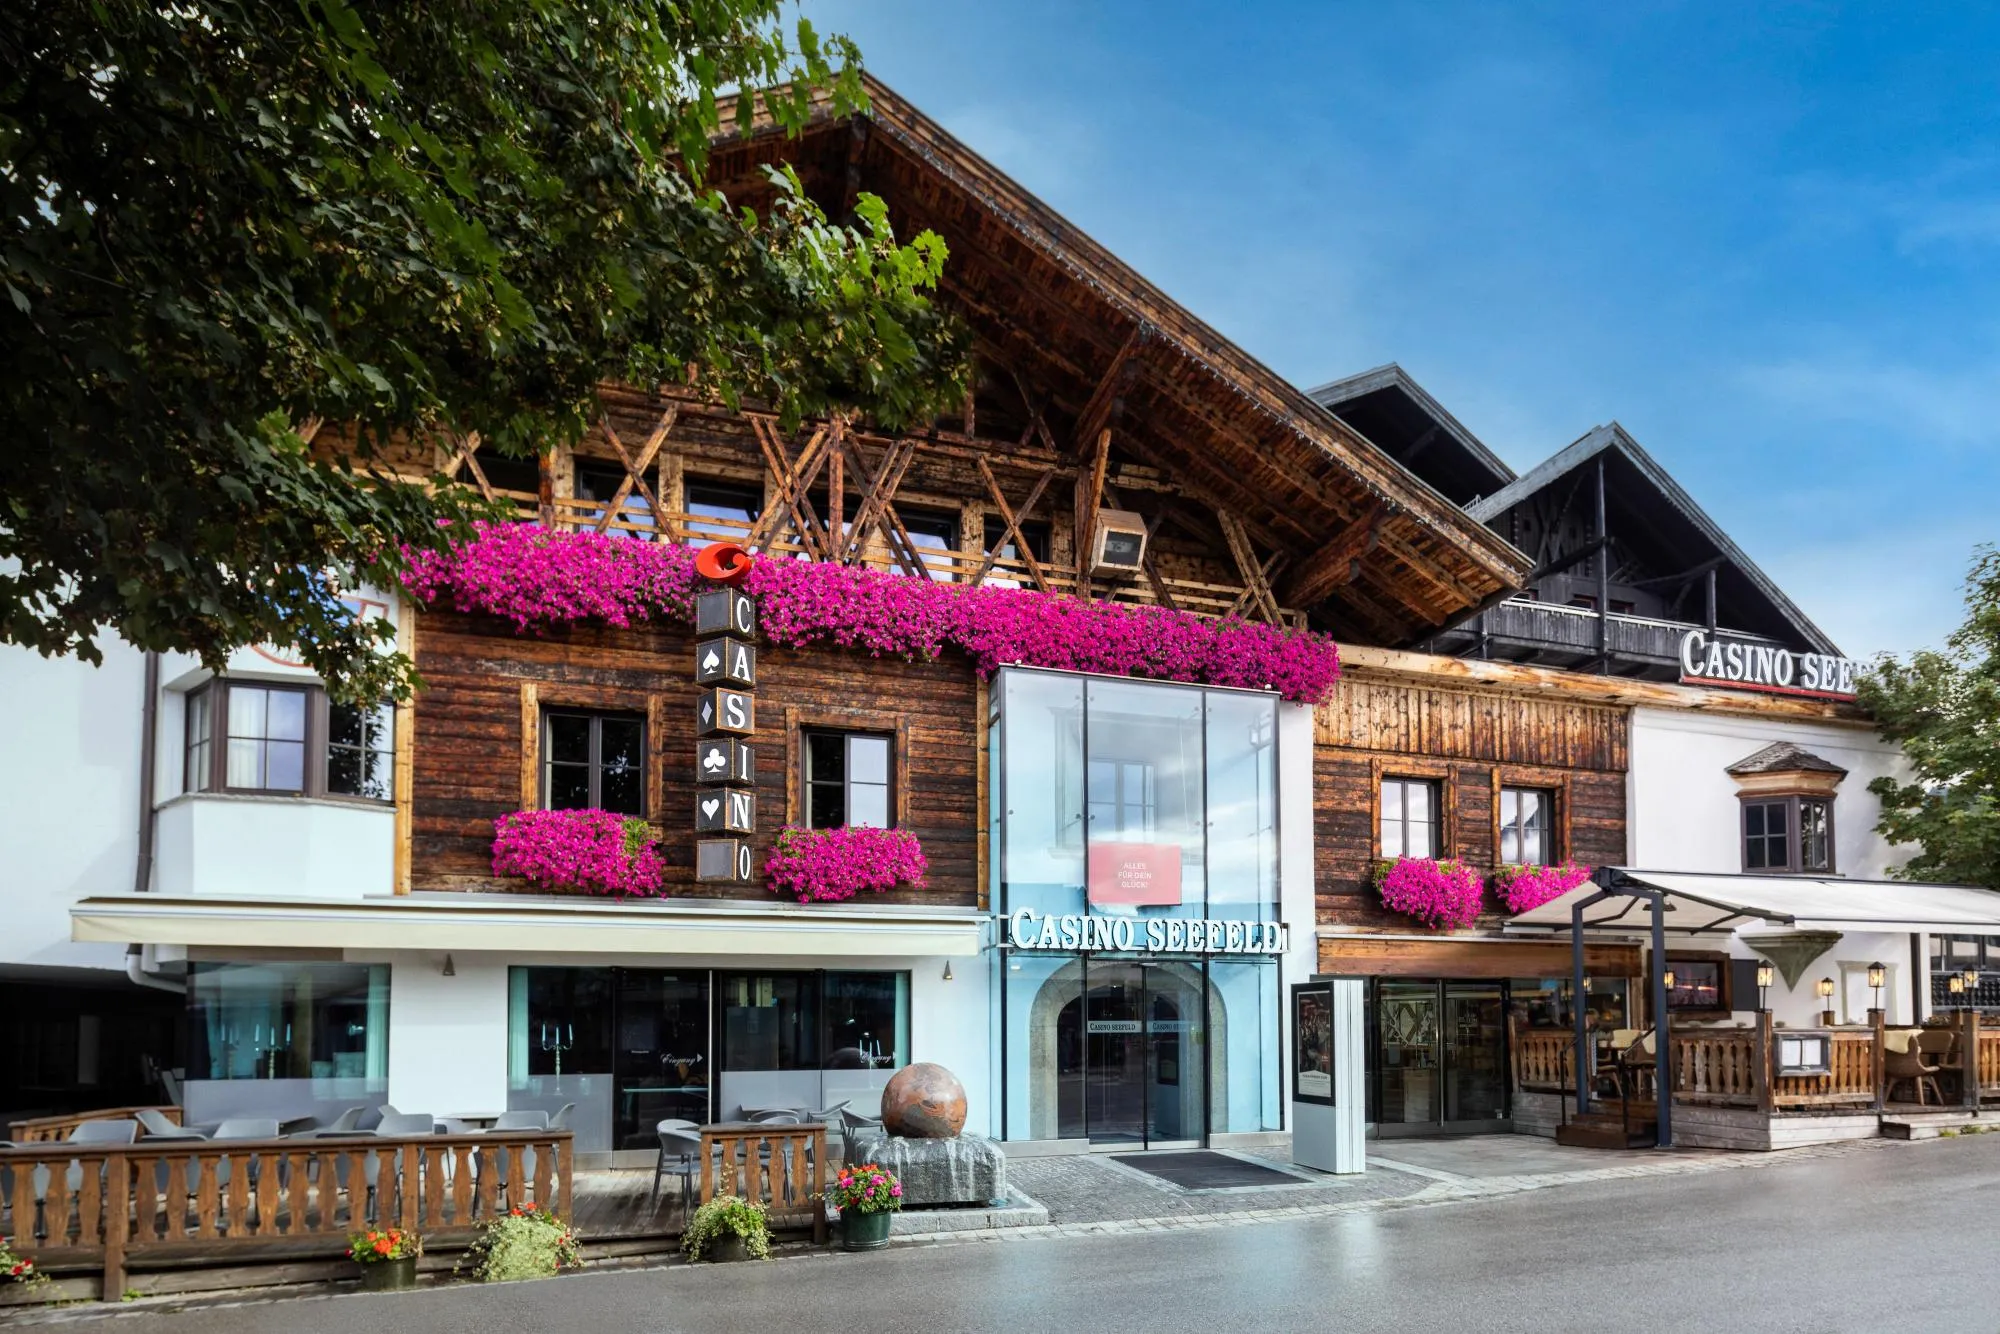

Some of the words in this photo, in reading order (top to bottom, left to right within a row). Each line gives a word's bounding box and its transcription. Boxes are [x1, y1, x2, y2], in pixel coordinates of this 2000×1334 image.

[1682, 630, 1794, 686] CASINO
[726, 596, 751, 880] CASINO
[1118, 870, 1132, 879] FÜR
[1010, 907, 1135, 951] CASINO
[1146, 918, 1283, 953] SEEFELD
